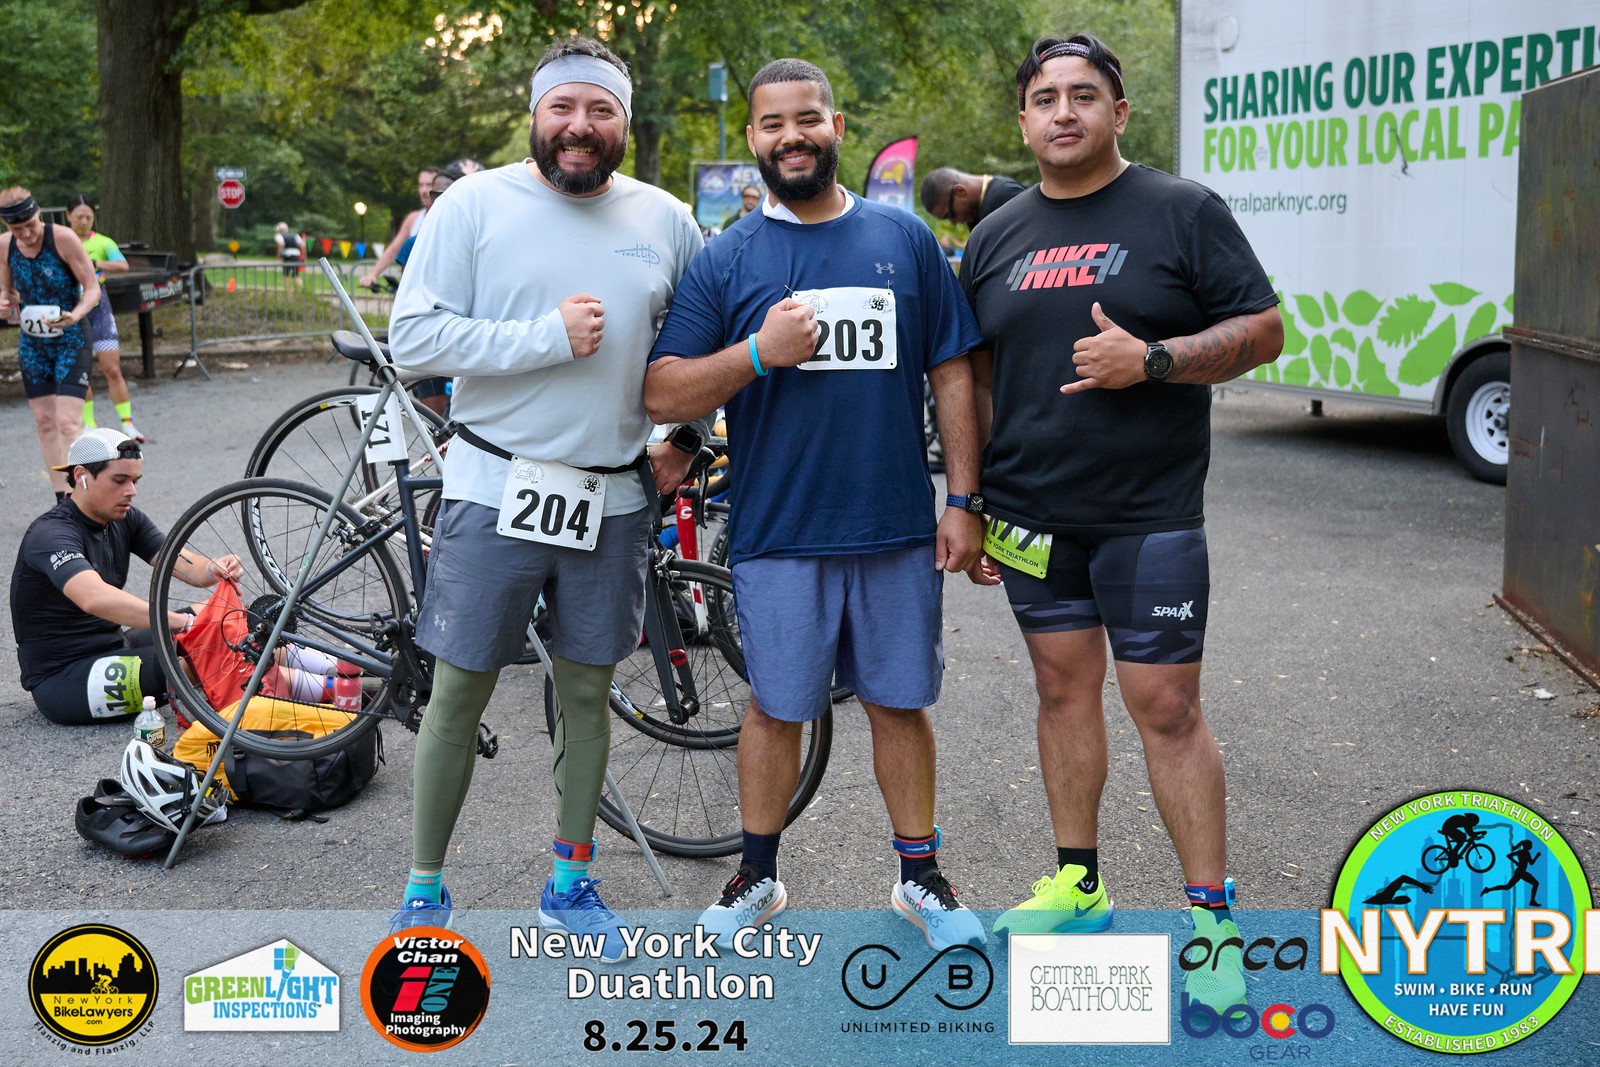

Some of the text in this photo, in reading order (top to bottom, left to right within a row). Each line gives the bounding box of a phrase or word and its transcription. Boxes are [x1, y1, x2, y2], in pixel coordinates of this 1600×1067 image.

[1203, 25, 1600, 124] SHARING OUR EXPERTI
[1203, 125, 1257, 174] FOR
[1266, 117, 1348, 171] YOUR
[1357, 105, 1466, 165] LOCAL
[220, 186, 243, 199] STOP
[1019, 243, 1109, 291] NIKE
[808, 318, 884, 362] 203
[510, 488, 590, 541] 204
[993, 541, 1005, 553] YORK
[1006, 549, 1039, 568] TRIATHLON
[103, 662, 131, 712] 149
[735, 888, 776, 926] BROOKS
[903, 891, 944, 929] BROOKS
